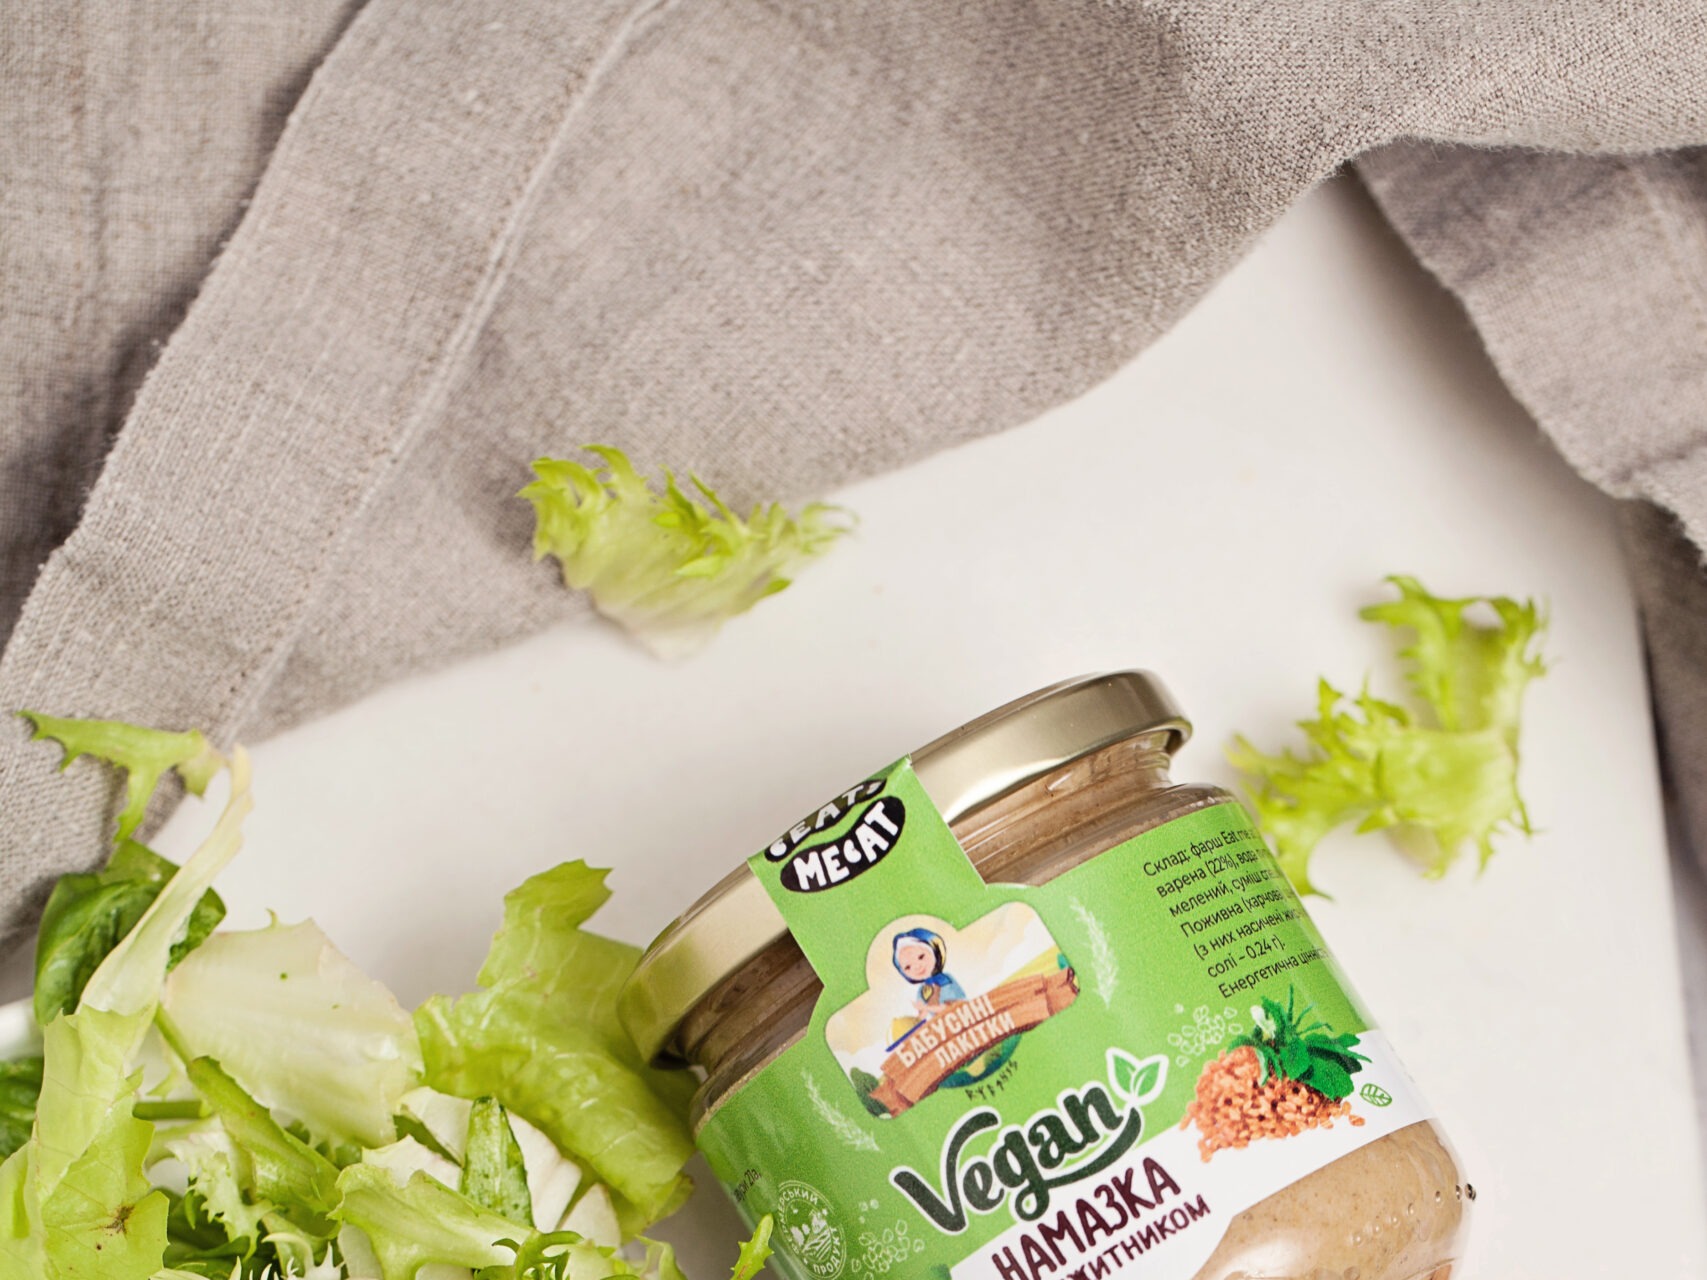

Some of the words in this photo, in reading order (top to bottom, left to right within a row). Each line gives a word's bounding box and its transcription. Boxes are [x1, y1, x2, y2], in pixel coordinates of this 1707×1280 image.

[1142, 850, 1192, 877] Склад:
[1190, 836, 1223, 859] фарш
[1221, 829, 1241, 846] Eat
[1155, 868, 1207, 898] варена
[1205, 853, 1240, 879] (22%),
[1168, 880, 1234, 918] мелений,
[1231, 873, 1262, 893] суміш
[1179, 903, 1244, 938] Поживна
[1193, 943, 1209, 961] (з
[1211, 931, 1237, 955] них
[1235, 909, 1285, 940] насичені
[1206, 953, 1238, 978] солі
[1245, 938, 1272, 959] 0.24
[1218, 956, 1300, 998] Енергетична
[894, 994, 996, 1068] БАБУСИНІ
[934, 1011, 1016, 1068] ЛАКІТКИ
[893, 1086, 1142, 1232] Vegan
[813, 1227, 841, 1275] ПРОДУКТ
